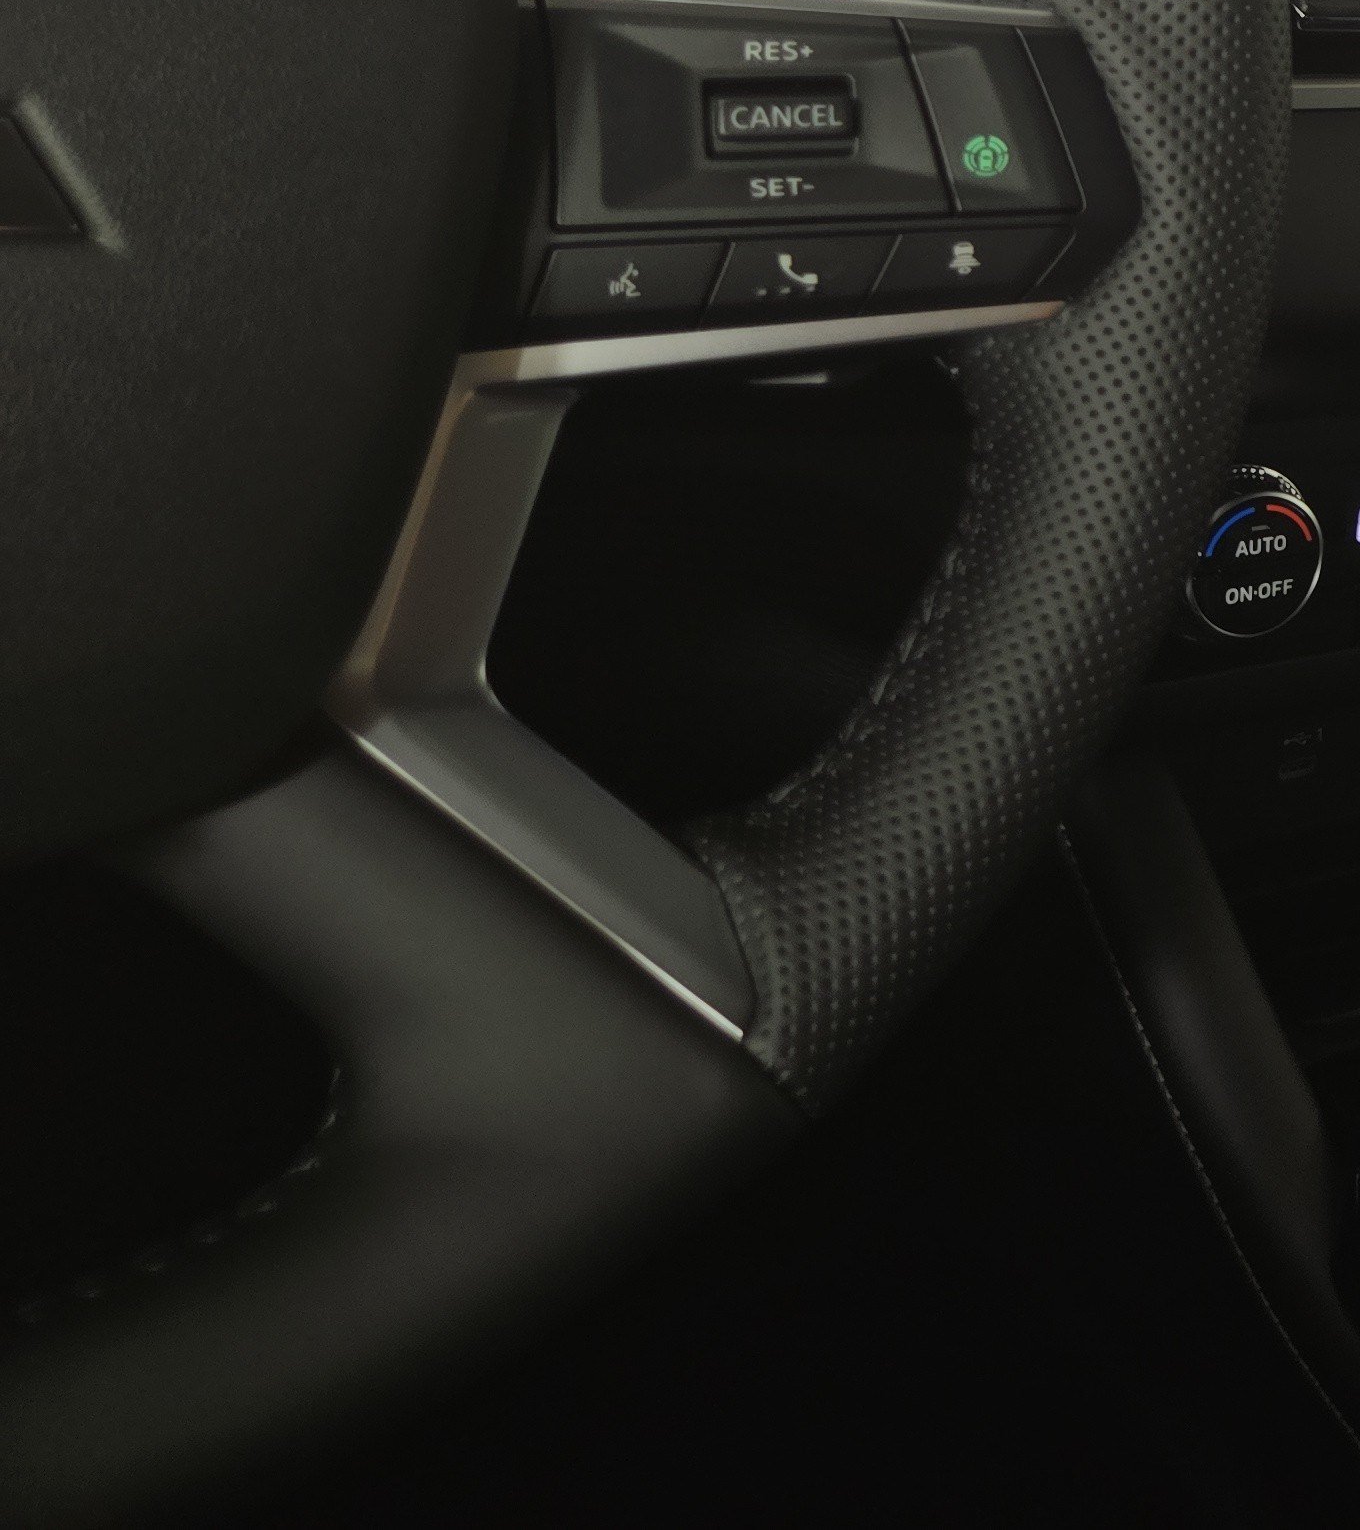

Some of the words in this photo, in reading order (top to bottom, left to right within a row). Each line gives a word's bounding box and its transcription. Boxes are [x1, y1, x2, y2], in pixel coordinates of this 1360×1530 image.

[744, 40, 814, 62] RES+
[730, 104, 844, 130] CANCEL
[749, 177, 815, 198] SET-
[1235, 535, 1287, 558] AUTO
